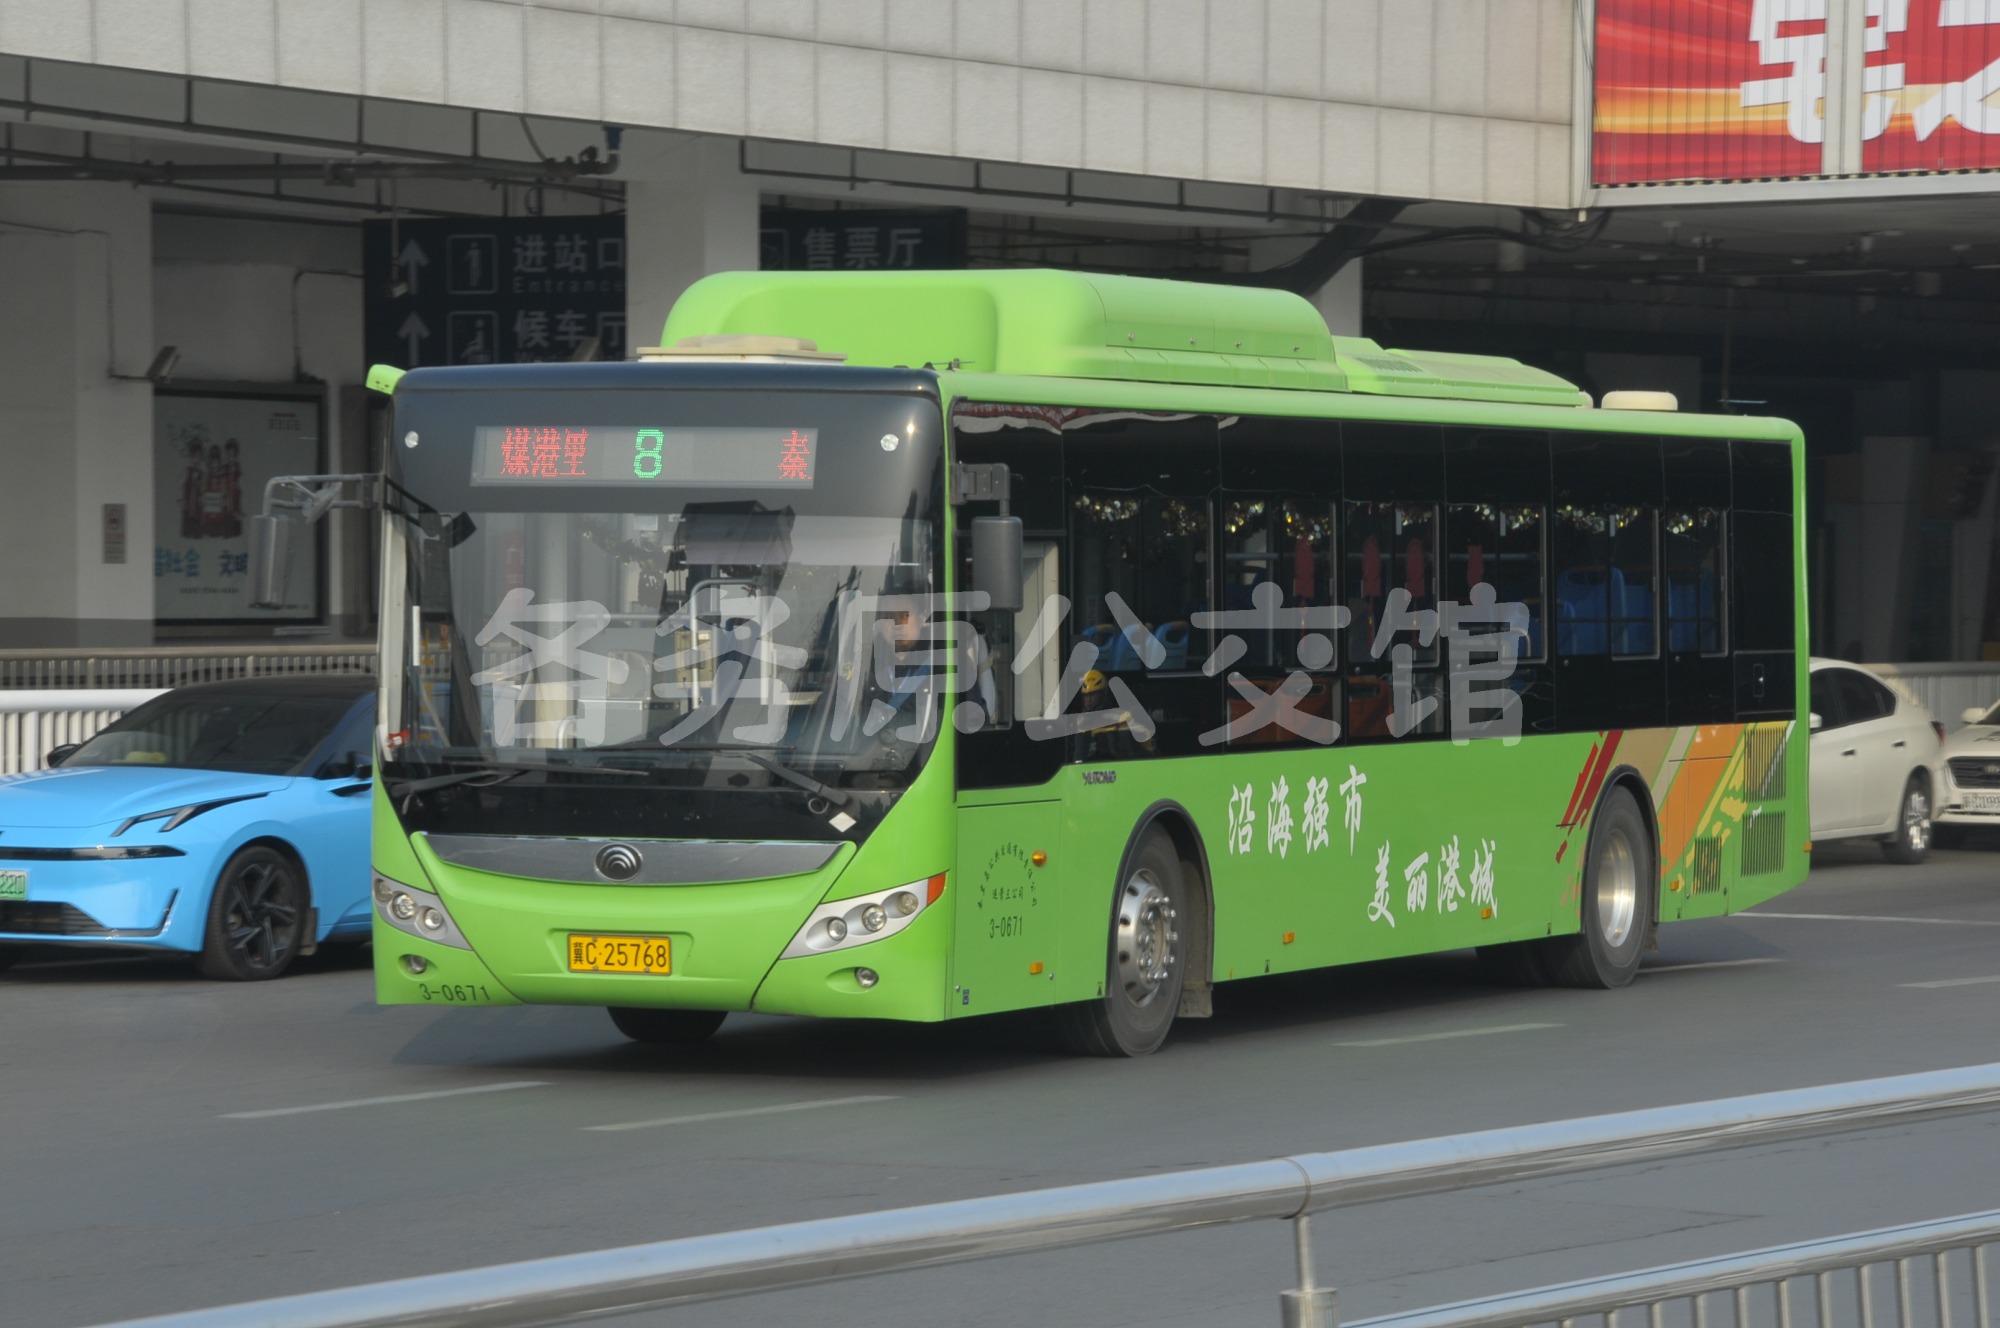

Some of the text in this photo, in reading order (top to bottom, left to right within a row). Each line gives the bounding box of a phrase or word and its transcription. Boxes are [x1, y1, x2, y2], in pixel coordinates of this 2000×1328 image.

[513, 233, 625, 273] 进站口
[803, 228, 922, 269] 售票厅
[513, 277, 625, 294] Entrance
[513, 310, 625, 348] 候车厅
[633, 429, 664, 478] 8
[1082, 770, 1117, 786] YUTONG
[1228, 764, 1367, 859] 沿海强市
[1367, 835, 1498, 928] 美丽港城
[989, 916, 1023, 939] 3-0671
[419, 983, 491, 1002] 3-0671
